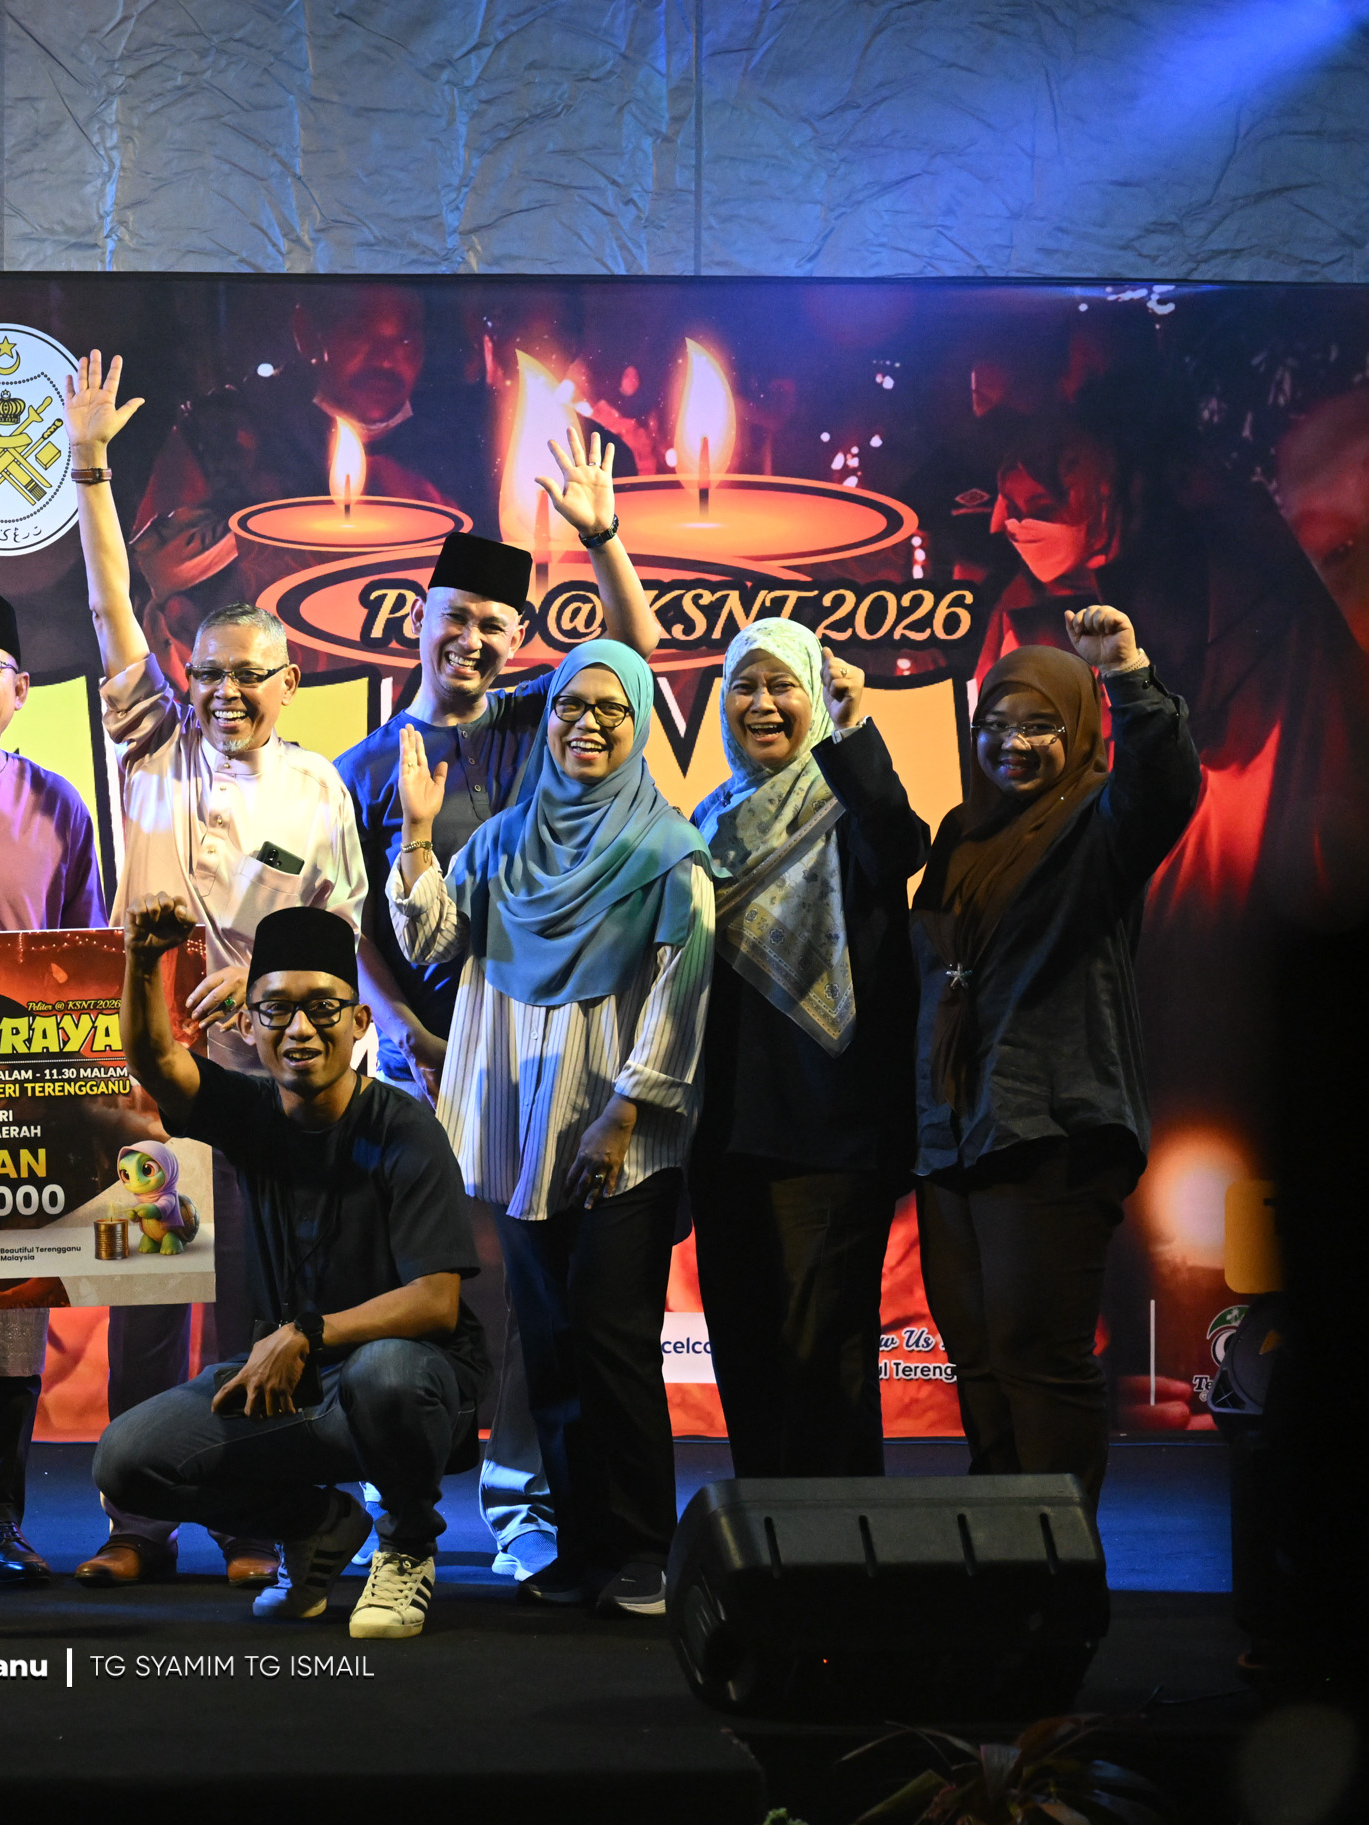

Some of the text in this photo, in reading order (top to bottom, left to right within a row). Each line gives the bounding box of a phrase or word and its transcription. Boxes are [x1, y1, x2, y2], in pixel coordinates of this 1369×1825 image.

[547, 591, 603, 643] @
[818, 589, 974, 641] 2026
[55, 1001, 65, 1010] @
[67, 1000, 97, 1010] KSNT
[96, 999, 121, 1009] 2026
[44, 1068, 77, 1080] 11.30
[80, 1066, 128, 1078] MALAM
[24, 1080, 131, 1097] TERENGGANU
[0, 1245, 81, 1254] Beautiful Terengganu
[0, 1254, 35, 1262] Malaysia
[661, 1337, 711, 1354] celco
[903, 1329, 934, 1349] Us
[893, 1362, 956, 1380] Tereng
